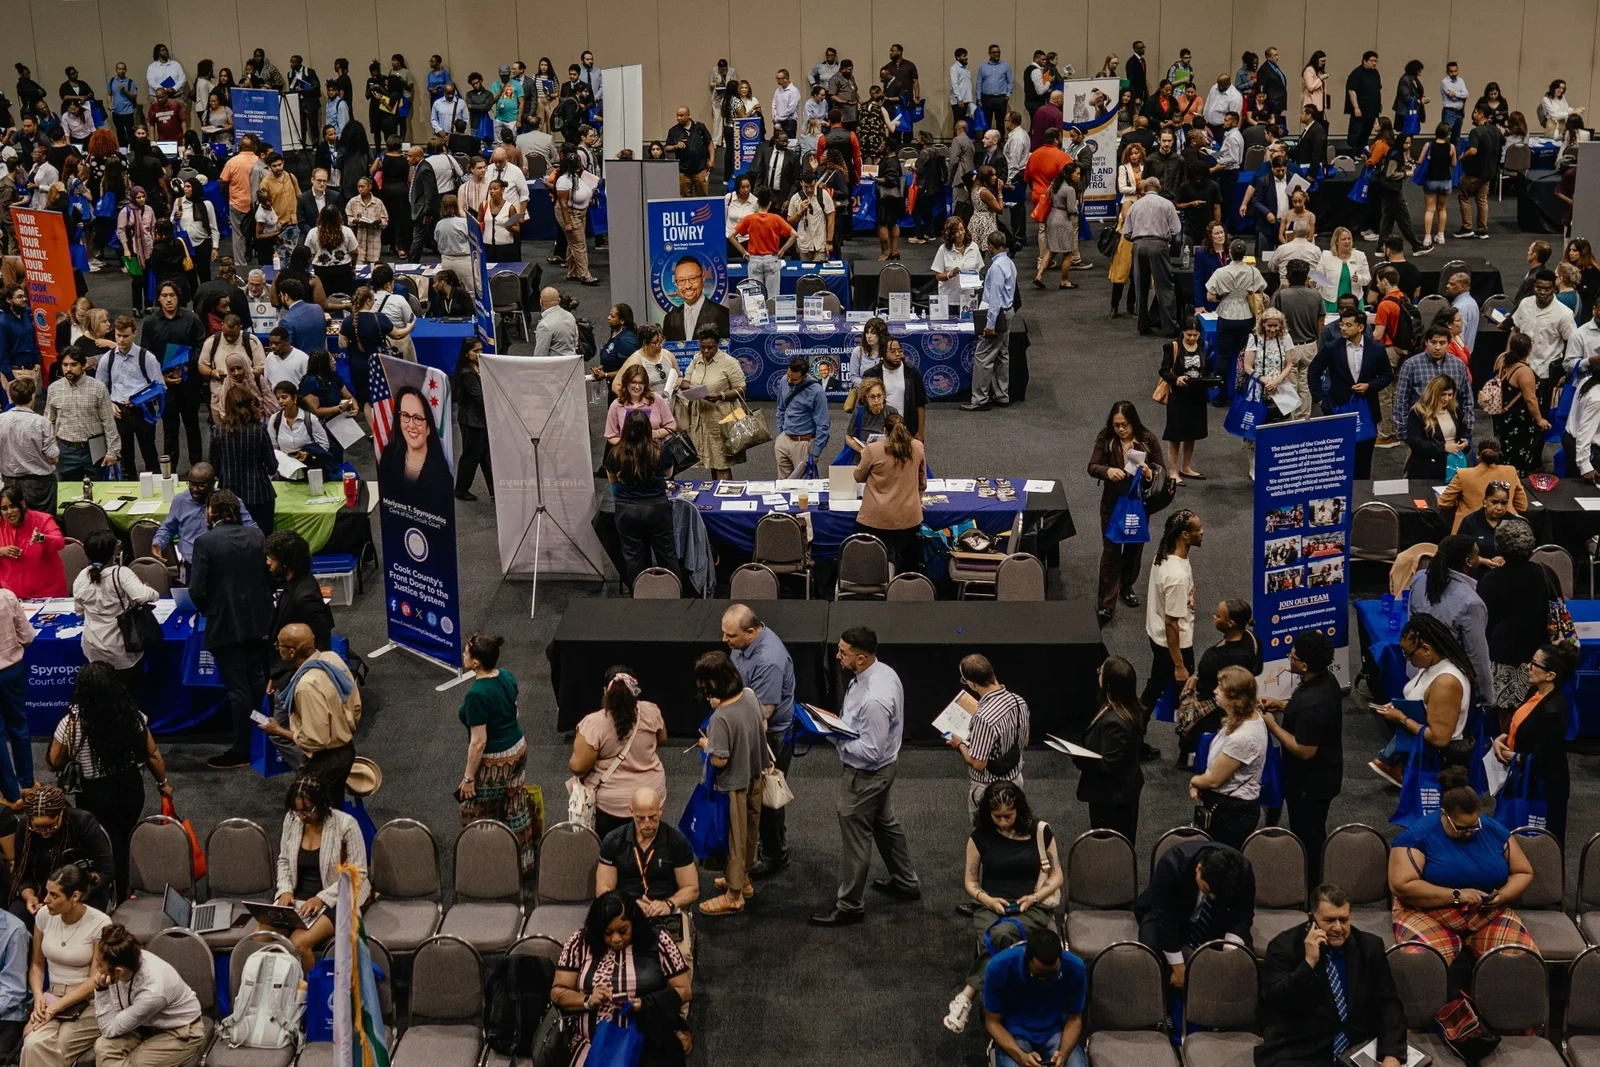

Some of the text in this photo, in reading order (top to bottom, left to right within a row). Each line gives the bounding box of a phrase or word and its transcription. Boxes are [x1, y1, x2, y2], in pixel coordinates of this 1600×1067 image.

[733, 121, 741, 170] COOK COUNTY
[1091, 174, 1103, 182] IES
[16, 213, 36, 225] YOUR
[662, 211, 688, 227] BILL
[19, 224, 42, 238] HOME.
[663, 225, 705, 242] LOWRY
[20, 236, 40, 248] YOUR
[22, 247, 49, 261] FAMILY.
[24, 258, 44, 271] YOUR
[26, 270, 55, 283] FUTURE.
[1281, 443, 1300, 451] mission
[1326, 437, 1344, 446] County
[1274, 450, 1299, 458] Assessor's
[1278, 456, 1299, 464] accurate
[1308, 451, 1335, 460] transparent
[1269, 463, 1298, 472] assessments
[1310, 456, 1336, 465] residential
[1279, 464, 1333, 477] commercial properties.
[1303, 471, 1330, 480] community
[1266, 475, 1348, 492] County through ethical stewardship
[1270, 489, 1287, 497] within
[1286, 487, 1295, 495] the
[1294, 485, 1315, 494] property
[413, 514, 428, 525] Circuit
[428, 520, 441, 530] Court
[393, 562, 443, 588] Cook County's
[389, 571, 449, 600] Front Door to the
[393, 581, 446, 608] Justice System
[1279, 593, 1330, 610] JOIN OUR TEAM
[1271, 628, 1288, 636] Connect
[30, 664, 82, 676] Spyropo
[28, 677, 55, 686] Court
[56, 677, 66, 685] of
